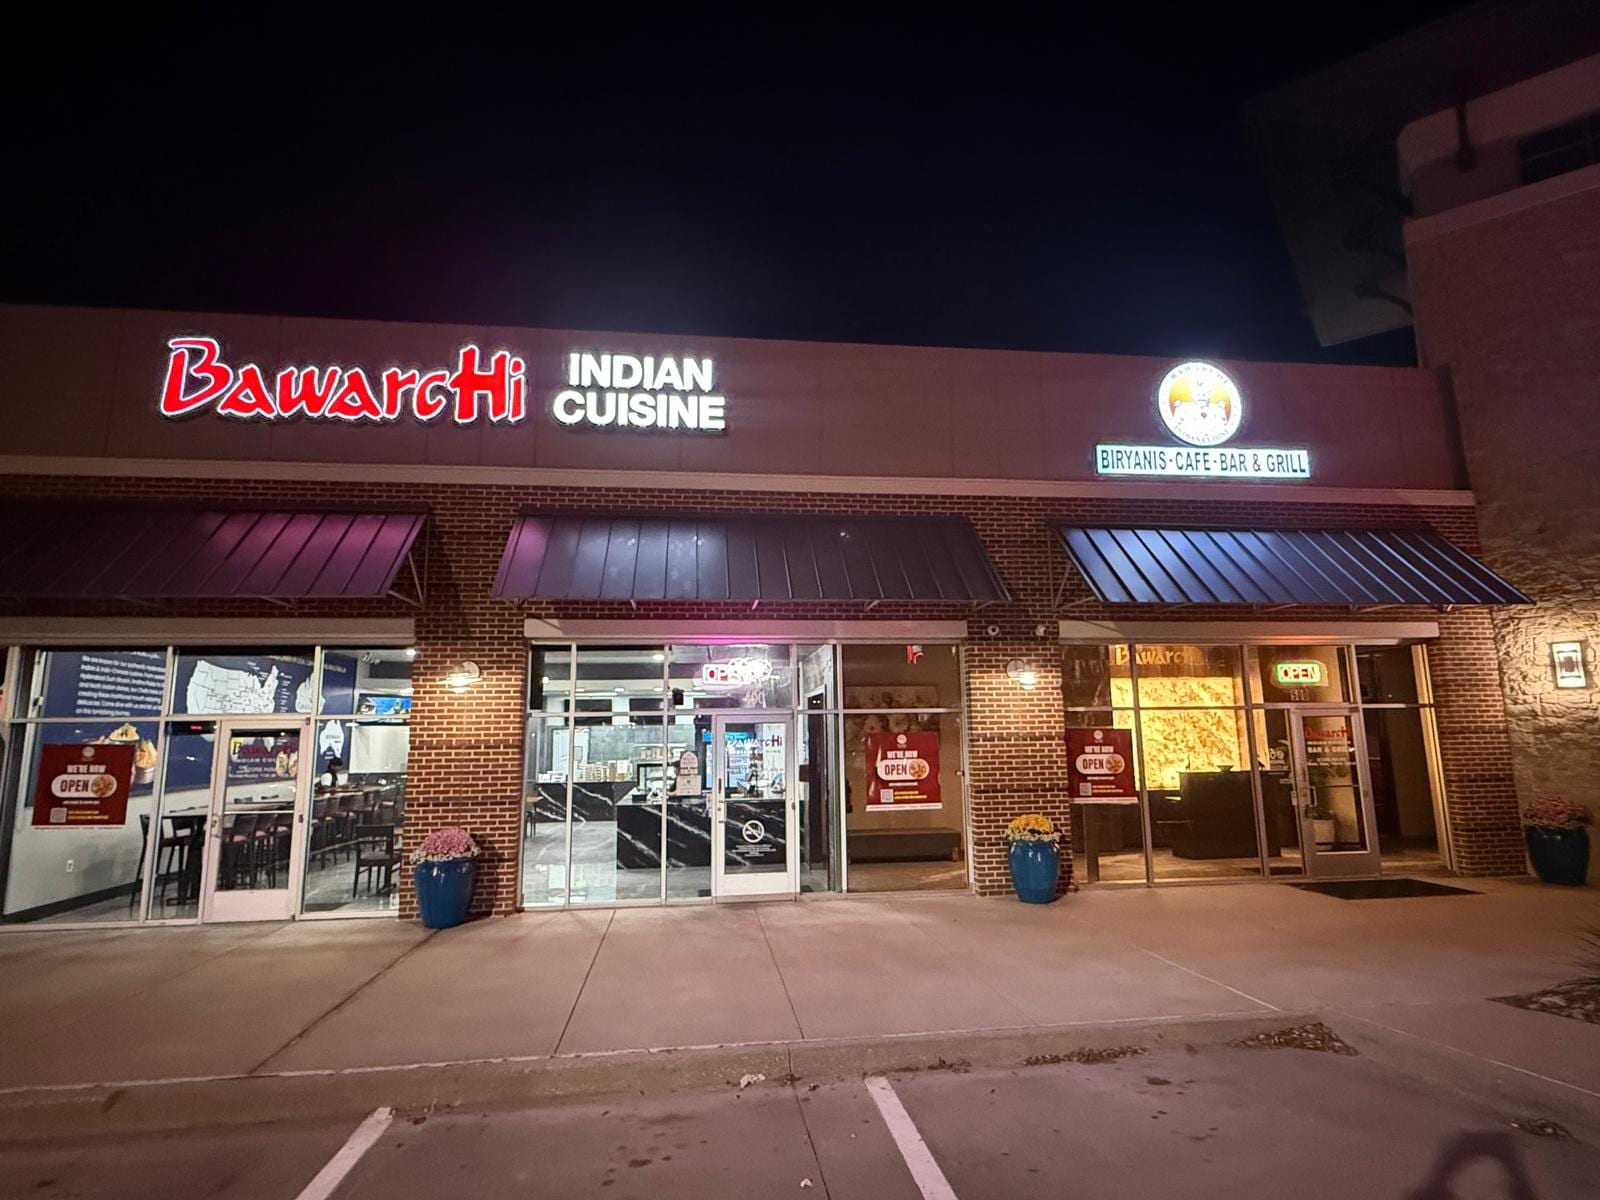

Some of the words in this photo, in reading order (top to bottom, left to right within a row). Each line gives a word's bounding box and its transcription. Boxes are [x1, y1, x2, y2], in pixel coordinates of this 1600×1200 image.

[569, 352, 714, 392] INDIAN
[552, 390, 726, 430] CUISINE
[1101, 449, 1167, 470] BIRYANIS
[1175, 451, 1211, 471] CAFE
[1220, 452, 1248, 471] BAR
[1252, 453, 1262, 472] &
[1266, 453, 1307, 473] GRILL
[1281, 665, 1318, 680] OPEN
[884, 764, 907, 776] OPEN
[1082, 758, 1104, 770] OPEN
[60, 779, 89, 792] OPEN
